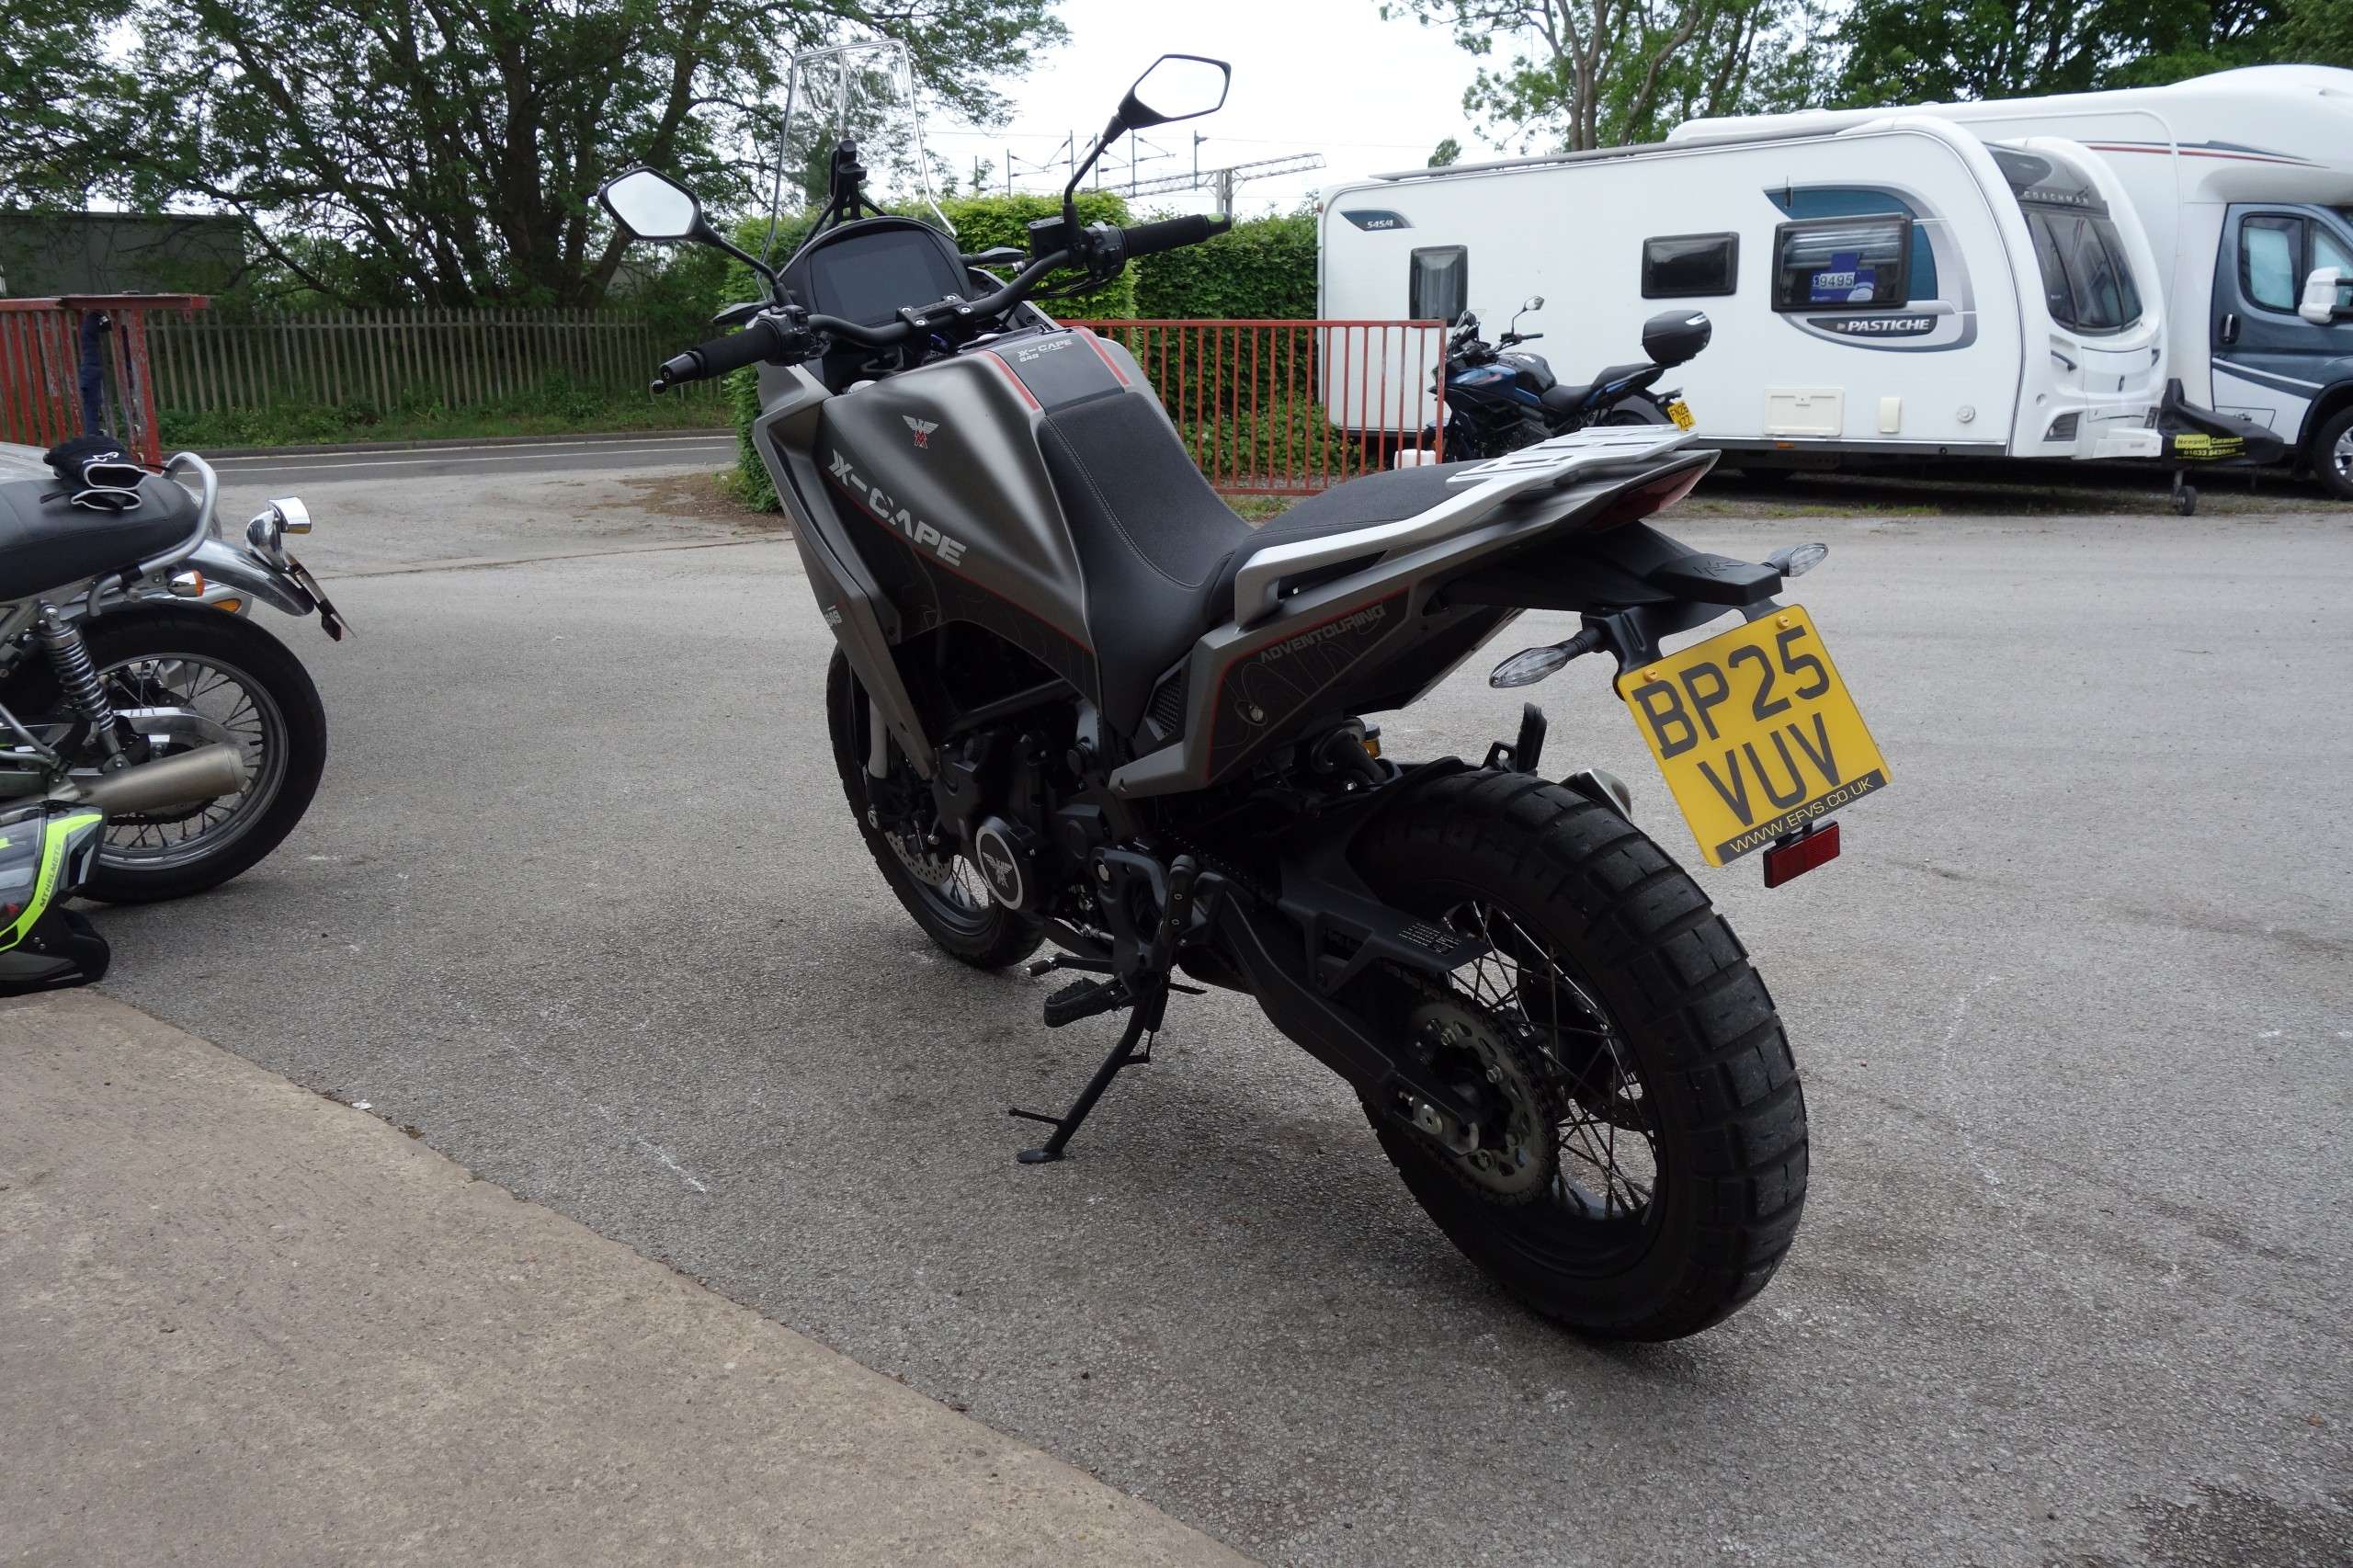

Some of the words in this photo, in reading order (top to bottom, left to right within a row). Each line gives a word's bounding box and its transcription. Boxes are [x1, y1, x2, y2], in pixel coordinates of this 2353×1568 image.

[2023, 190, 2089, 205] COACHMAN
[1017, 338, 1073, 357] X-CAPE
[1847, 318, 1930, 332] PASTICHE
[829, 448, 967, 567] X-CAPE
[1260, 602, 1387, 664] ADVENTOURING
[1631, 625, 1830, 760] BP25
[1697, 712, 1841, 827] VUV
[1730, 777, 1873, 853] WWW.EFVS.CO.UK
